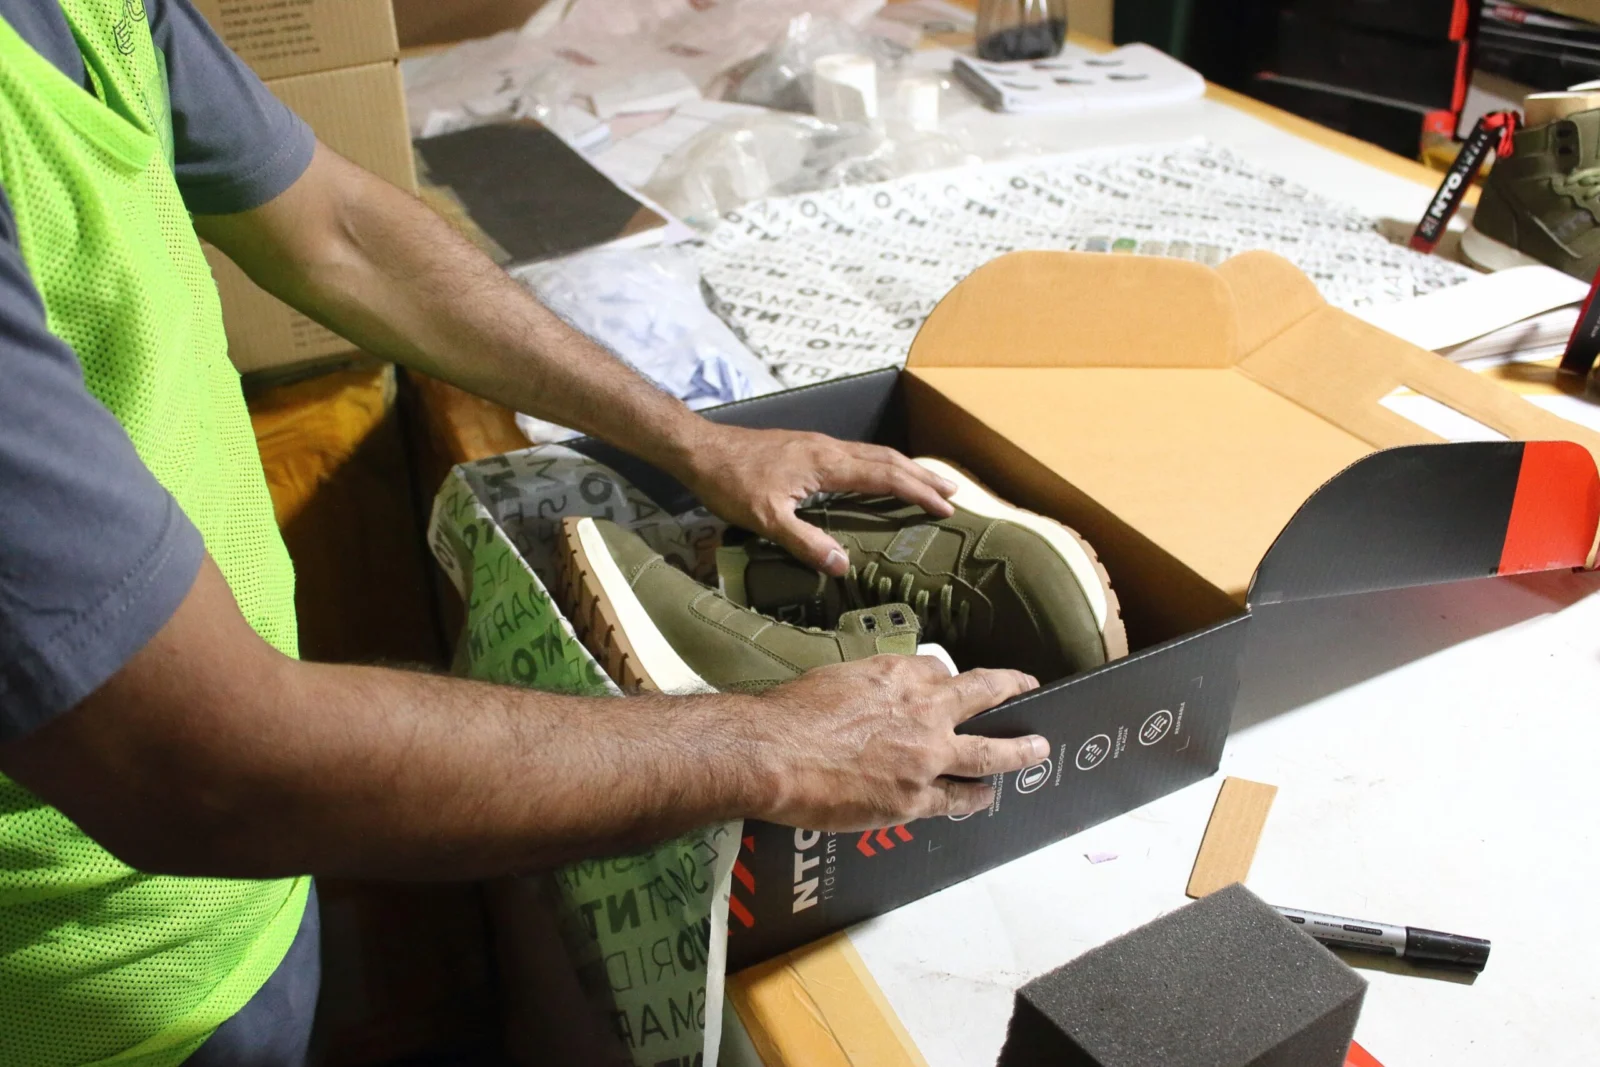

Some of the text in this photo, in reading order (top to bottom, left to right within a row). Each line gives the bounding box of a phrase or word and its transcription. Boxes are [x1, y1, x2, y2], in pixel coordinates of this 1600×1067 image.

[1429, 172, 1462, 218] NTO
[1121, 727, 1129, 744] AGUA
[1174, 701, 1186, 735] RESPIRABLE
[1113, 725, 1124, 759] RESISTENTE
[1055, 743, 1067, 787] PROTECCIONES
[822, 830, 837, 901] ridesma
